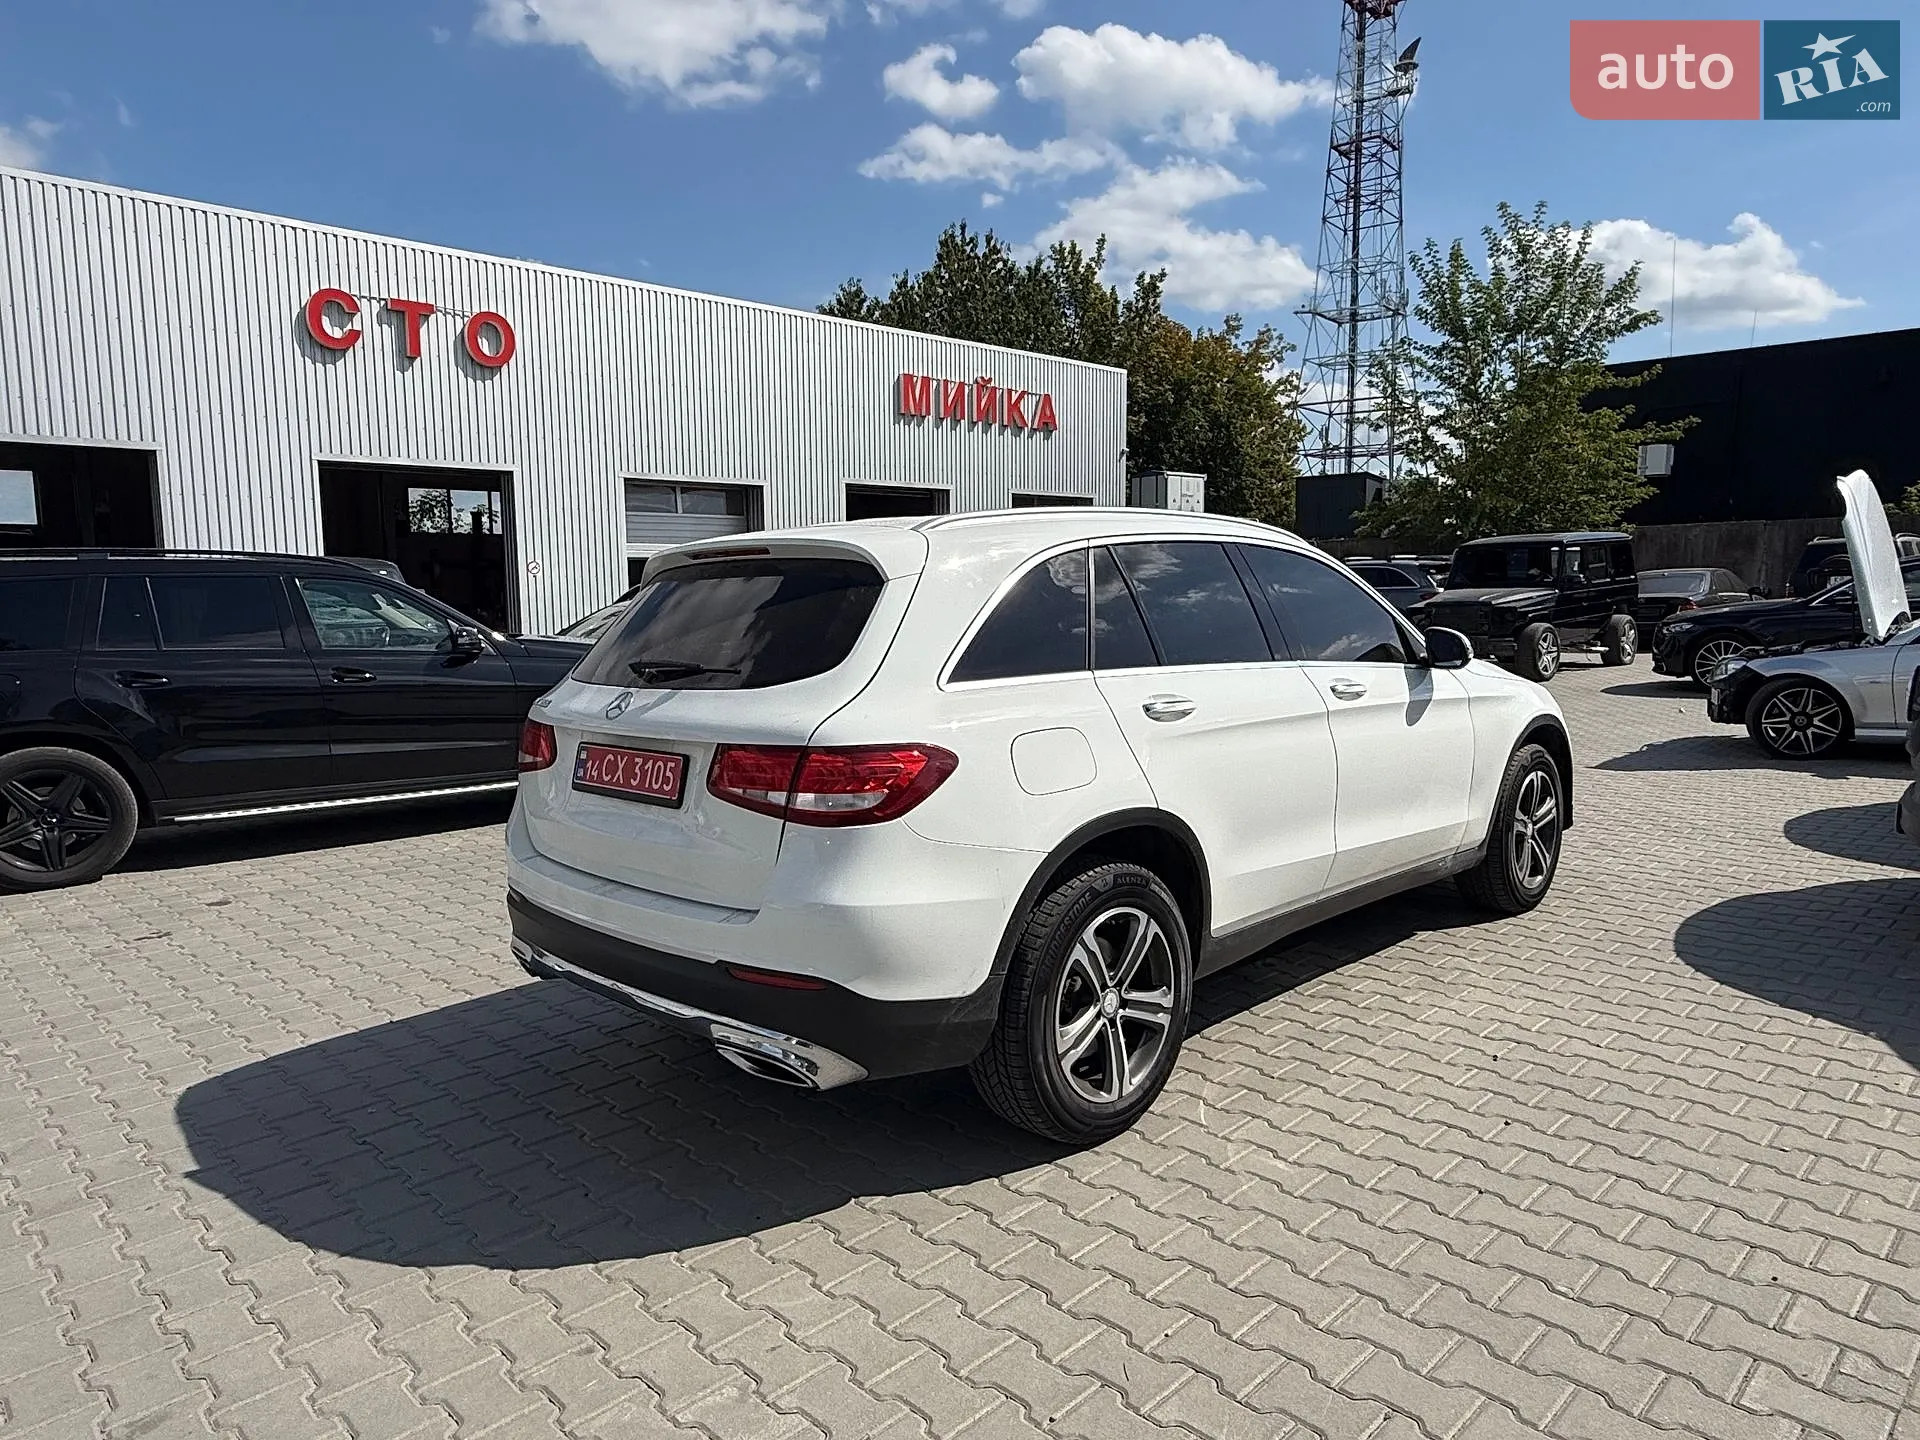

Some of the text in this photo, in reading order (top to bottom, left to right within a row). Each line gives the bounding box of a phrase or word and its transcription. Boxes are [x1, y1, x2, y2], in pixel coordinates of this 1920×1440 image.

[305, 287, 516, 368] СТО
[899, 373, 1058, 431] МИЙКА
[630, 757, 675, 792] 3105
